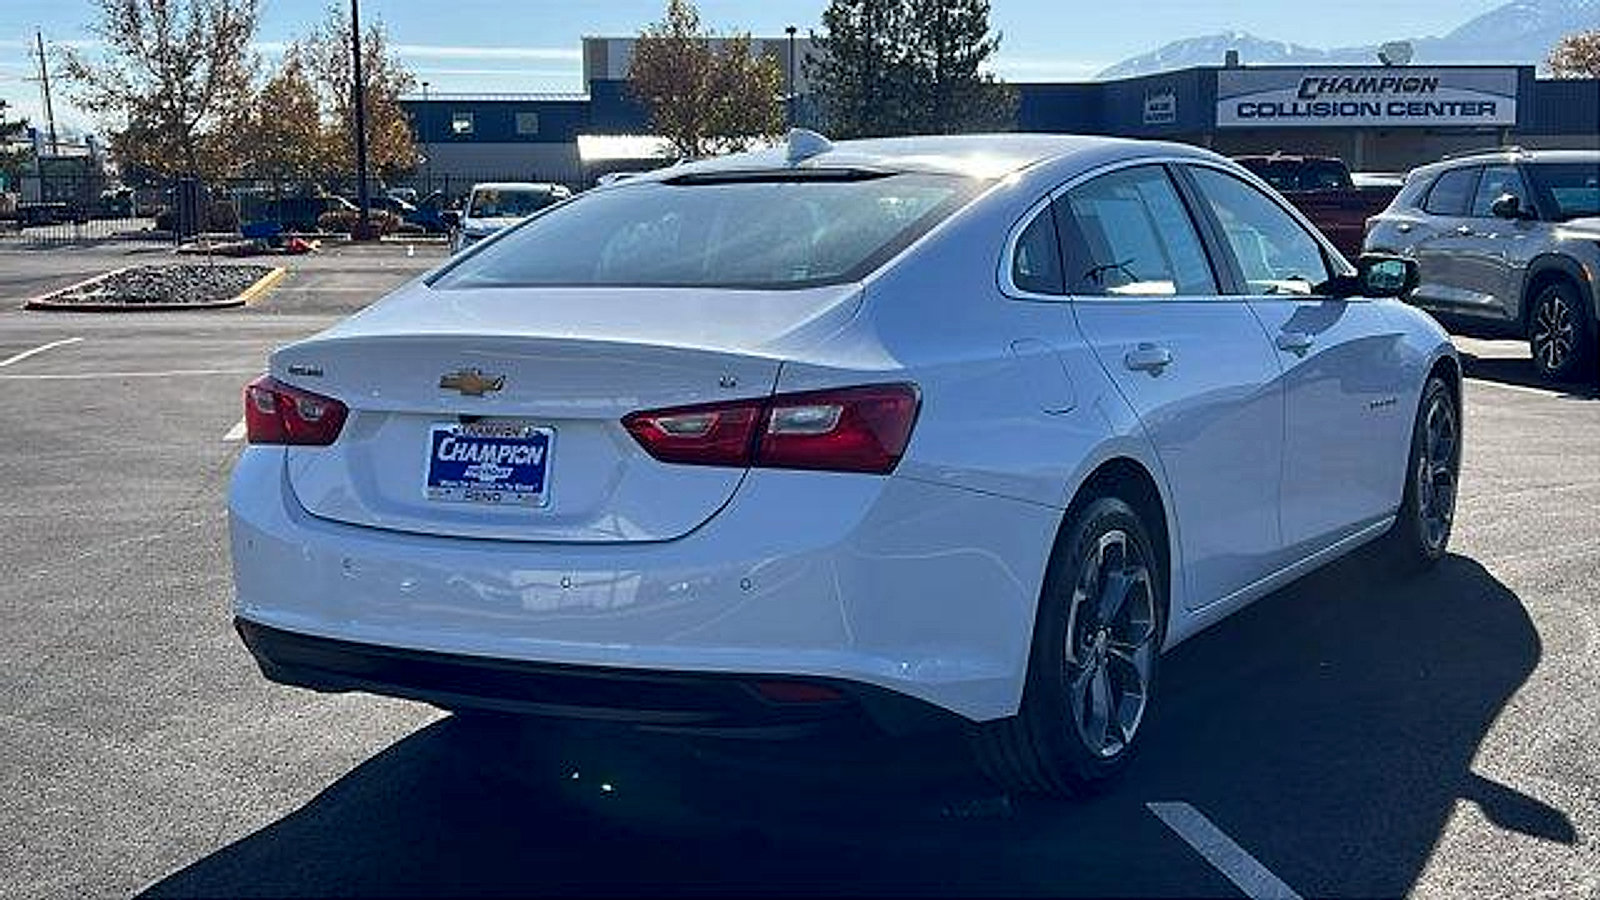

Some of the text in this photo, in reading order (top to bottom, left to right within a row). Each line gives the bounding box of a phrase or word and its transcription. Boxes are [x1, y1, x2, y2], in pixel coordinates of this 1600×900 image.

[1298, 77, 1440, 99] CHAMPION
[1237, 102, 1496, 117] COLLISION CENTER
[438, 437, 544, 465] CHAMPION
